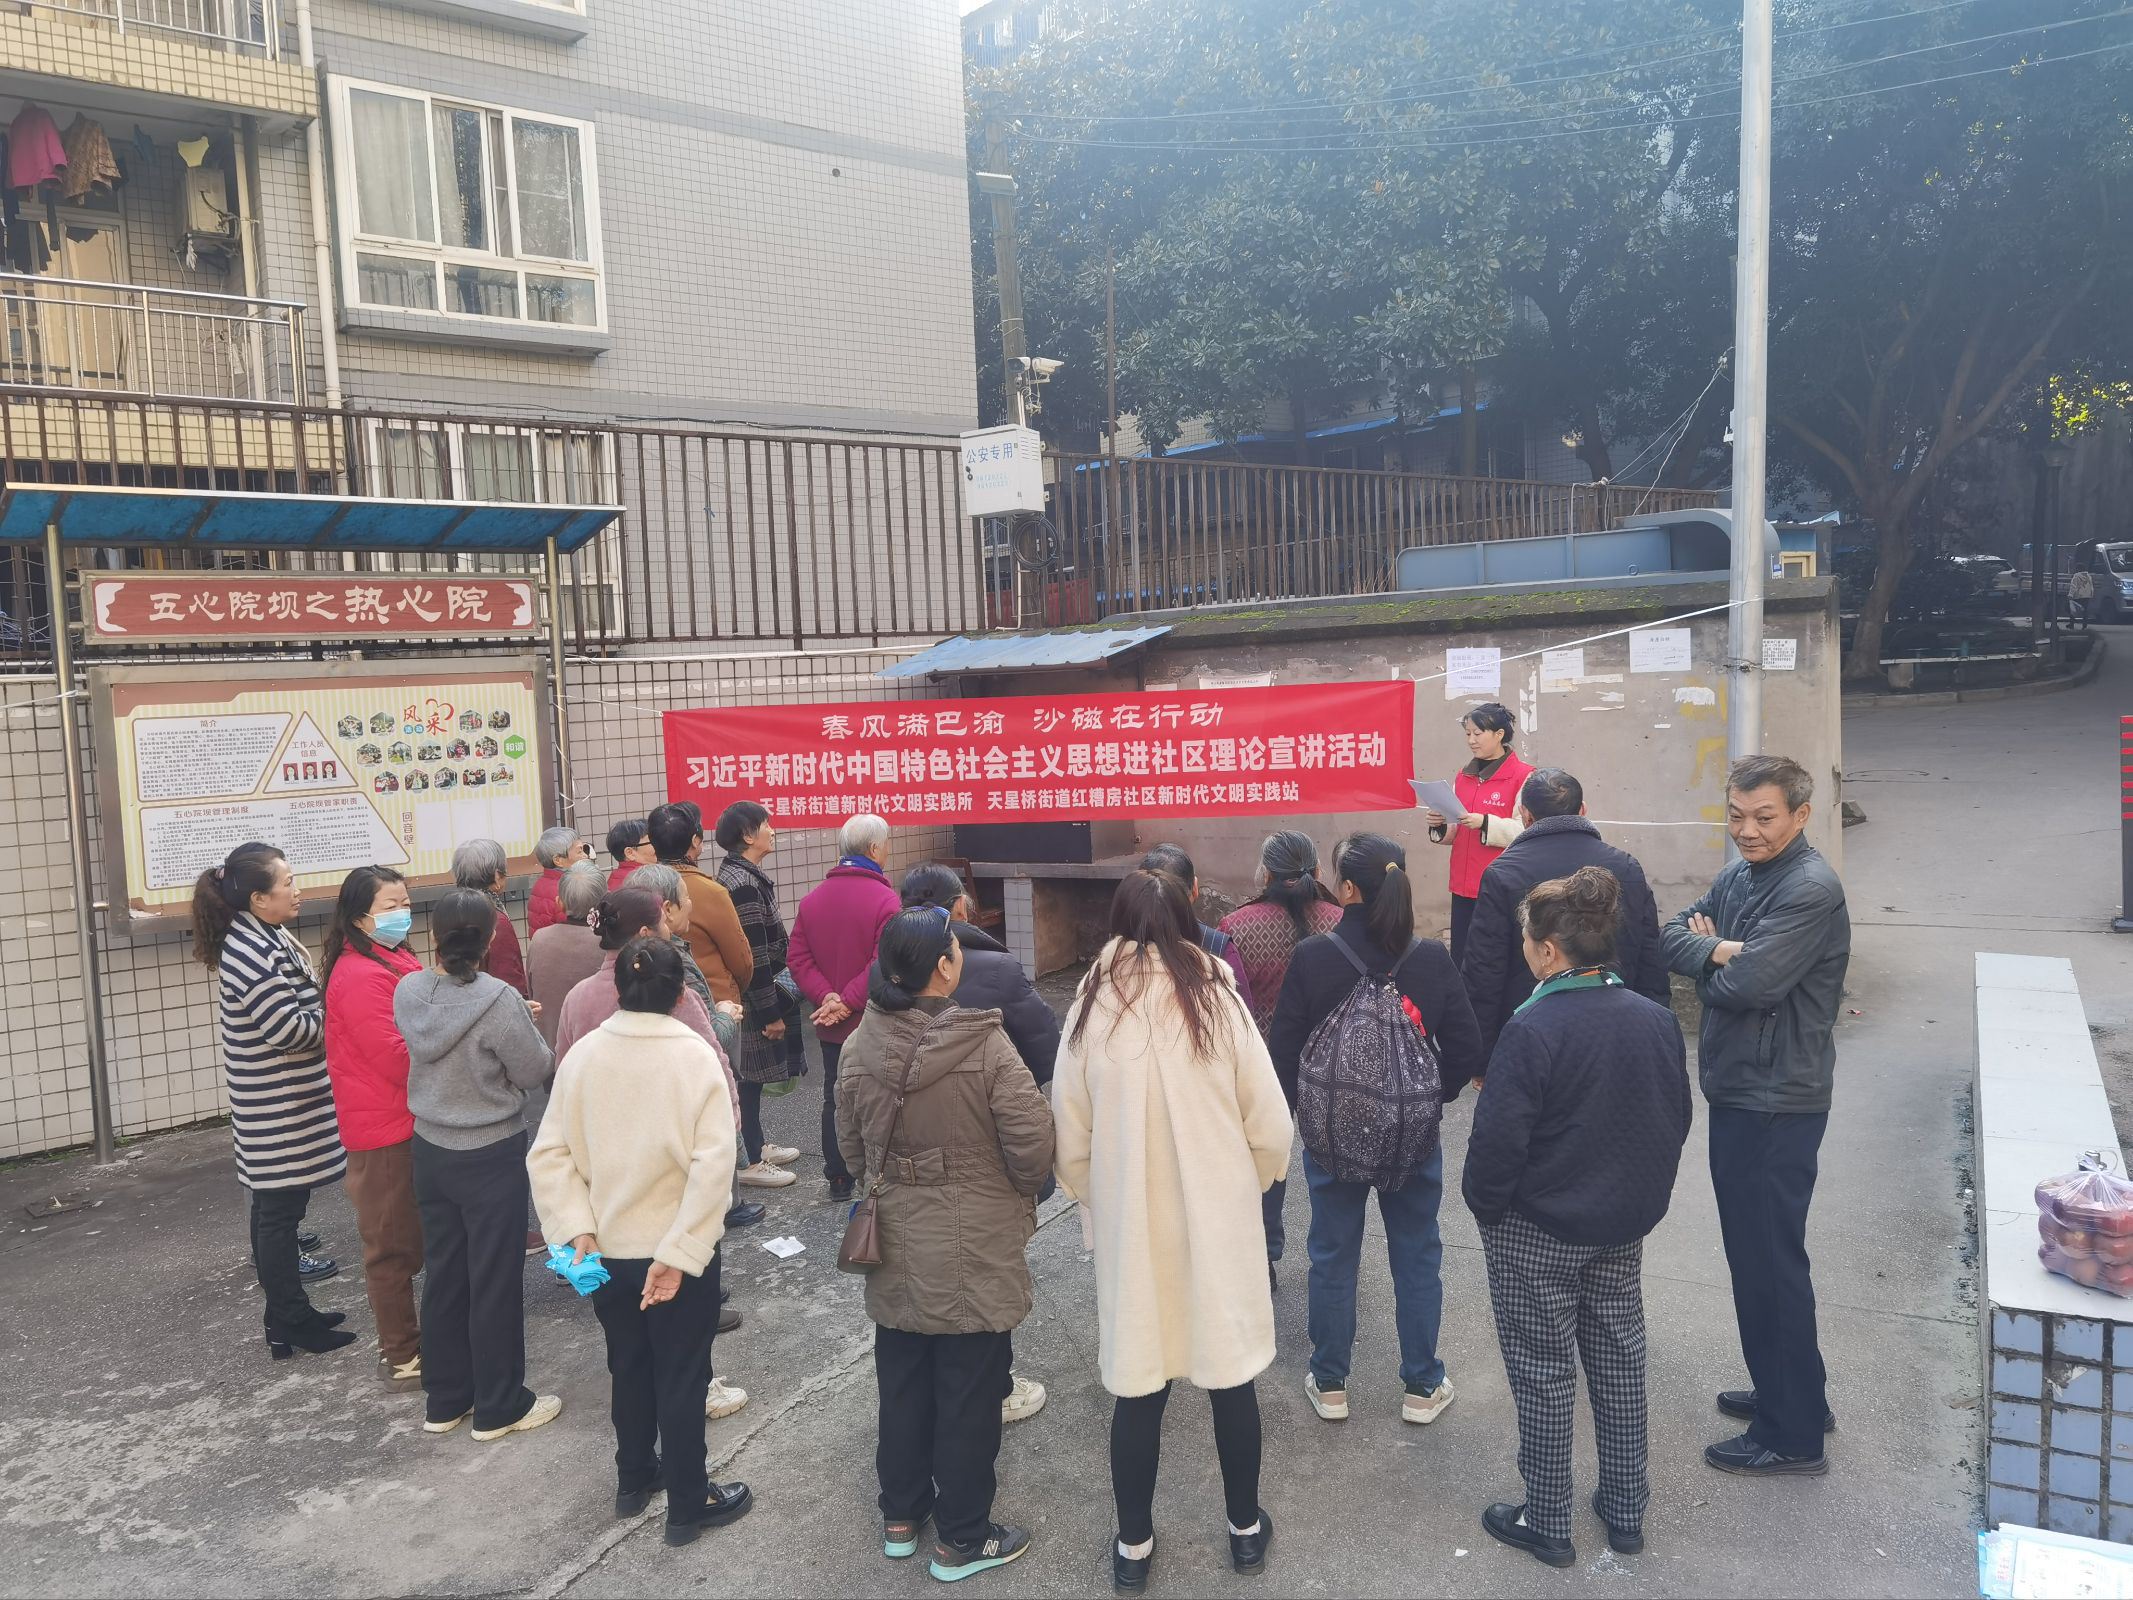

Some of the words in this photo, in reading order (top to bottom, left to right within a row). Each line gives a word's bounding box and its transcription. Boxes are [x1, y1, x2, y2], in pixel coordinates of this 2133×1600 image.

[966, 442, 1013, 464] 公安专用
[149, 584, 493, 625] 五心院坝之热心院
[403, 704, 448, 736] 风采
[821, 709, 1006, 741] 春风满巴渝
[1033, 702, 1225, 733] 沙磁在行动
[292, 740, 325, 749] 工作人员
[686, 731, 1386, 789] 习近平新时代中国特色社会主义思想进社区理论宣讲活动
[174, 805, 249, 819] 五心院坝管理制度
[759, 791, 974, 817] 天星桥街道新时代文明实践所
[987, 781, 1299, 811] 天星桥街道红糟房社区新时代文明实践站
[983, 1539, 999, 1556] N
